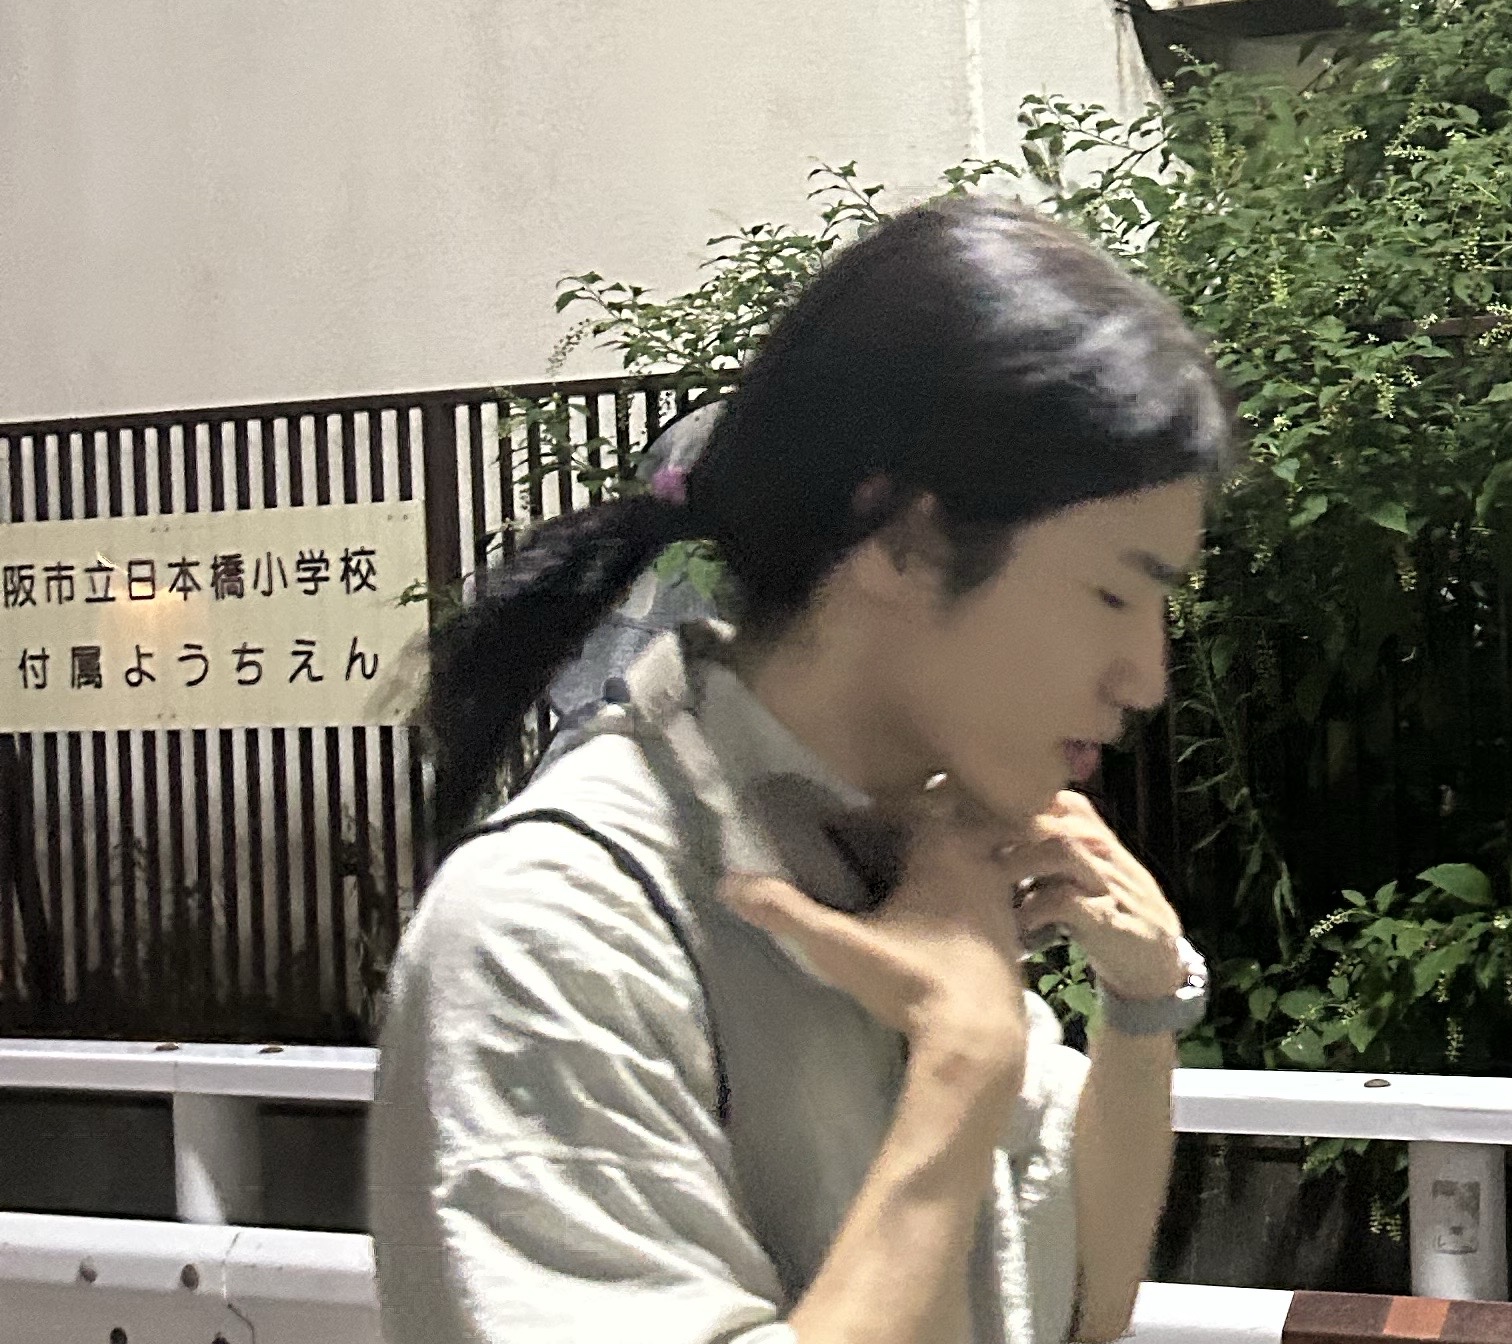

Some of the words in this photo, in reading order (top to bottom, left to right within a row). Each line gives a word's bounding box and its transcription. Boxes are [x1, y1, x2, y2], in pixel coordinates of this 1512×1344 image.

[2, 545, 378, 609] 阪市立日本橋小学校
[17, 636, 380, 690] 付属ようちえん
